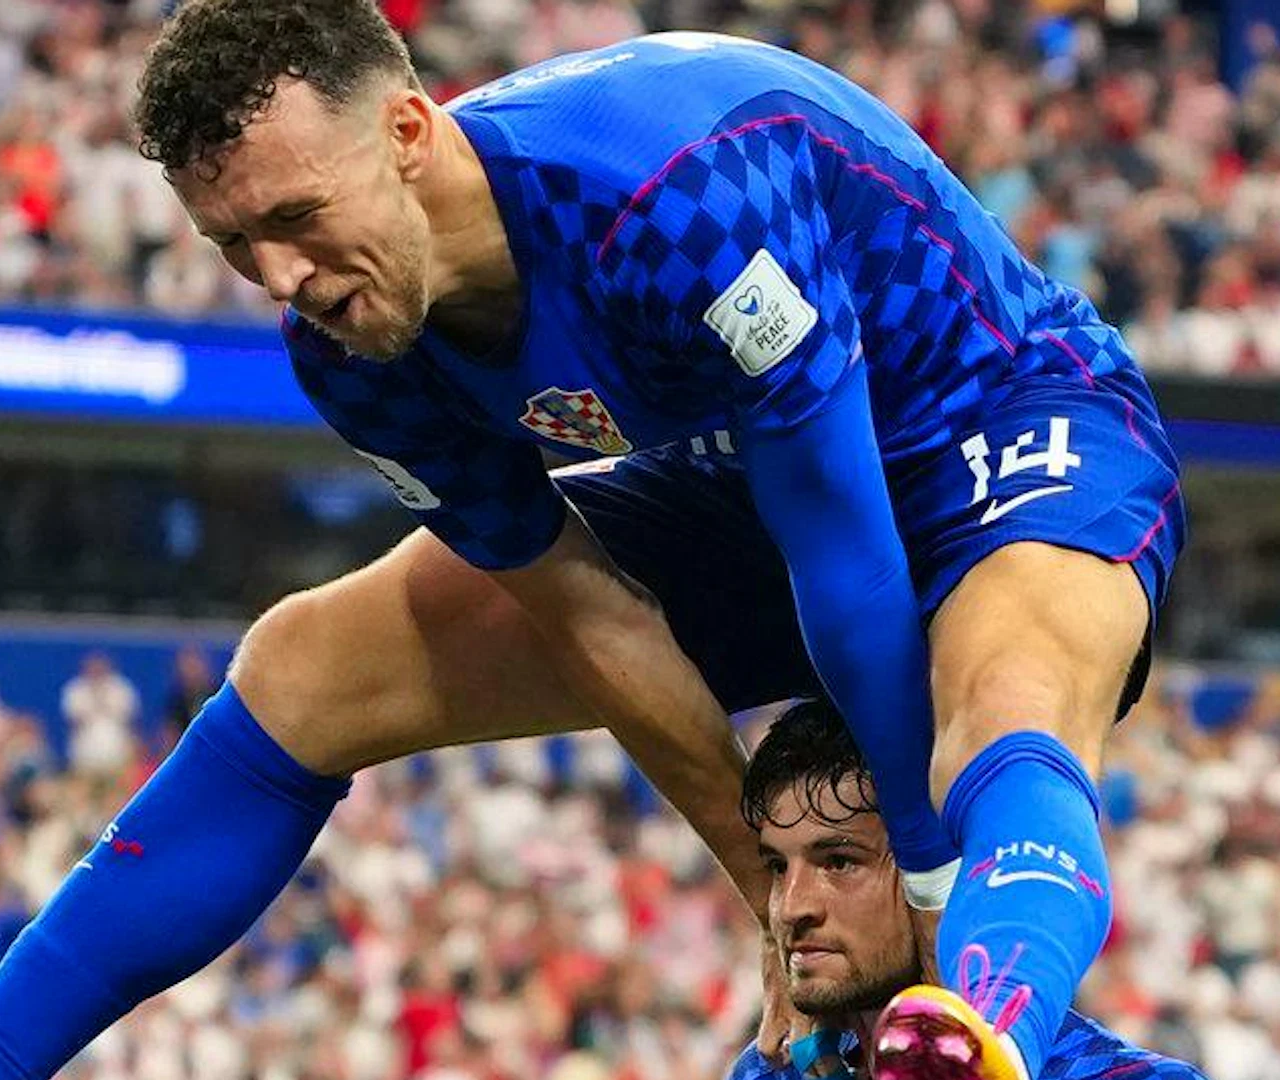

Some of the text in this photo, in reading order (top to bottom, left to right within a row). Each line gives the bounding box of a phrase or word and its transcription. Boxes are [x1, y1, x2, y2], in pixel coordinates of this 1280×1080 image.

[755, 312, 790, 350] PEACE
[959, 416, 1082, 506] 14
[995, 840, 1078, 873] HNS
